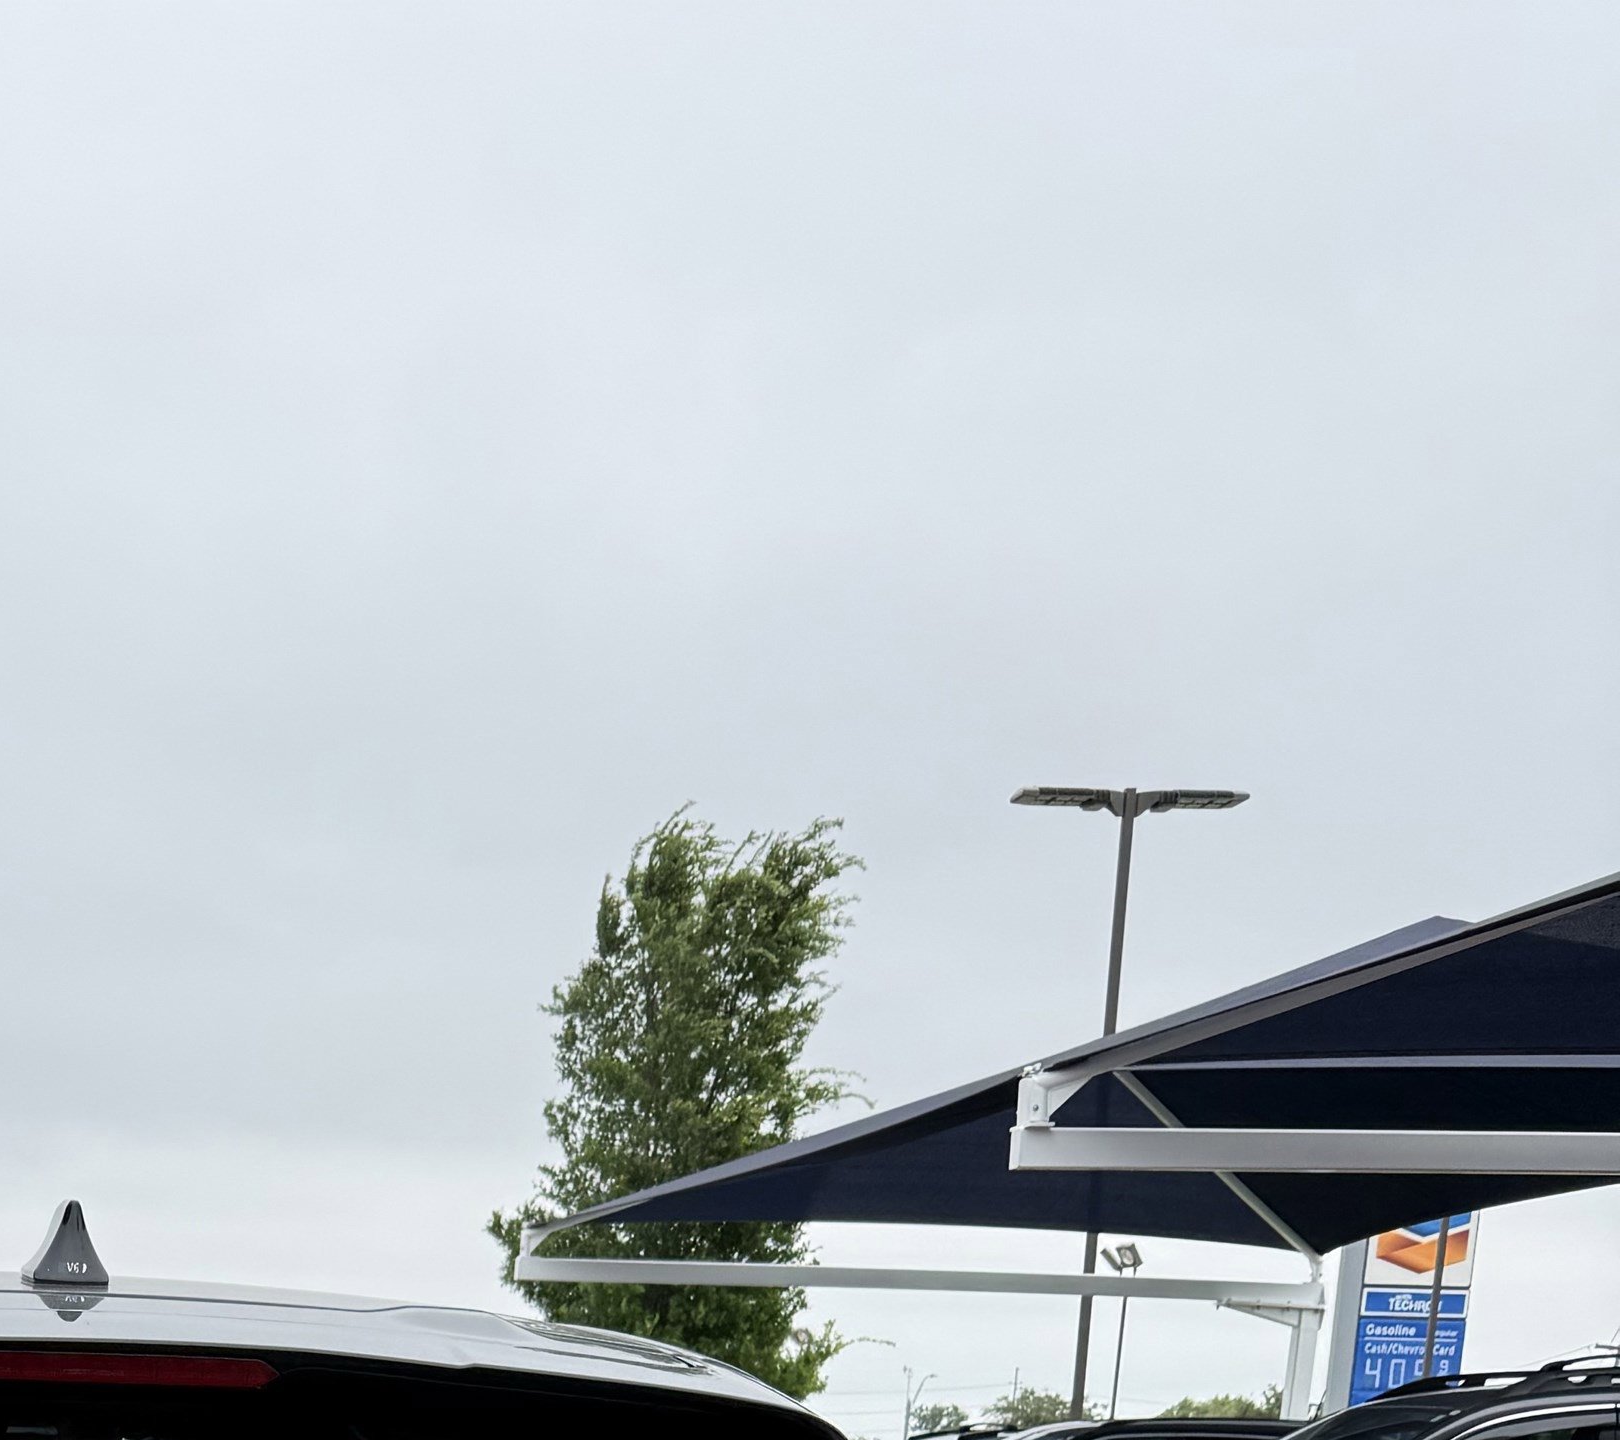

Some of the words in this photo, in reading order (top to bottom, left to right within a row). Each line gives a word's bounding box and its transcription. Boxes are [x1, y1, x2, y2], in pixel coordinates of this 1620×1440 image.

[1389, 1297, 1442, 1313] TECHRO
[1365, 1323, 1416, 1336] Gasoline
[1364, 1341, 1426, 1356] Cash/Chevro
[1433, 1344, 1456, 1356] Card
